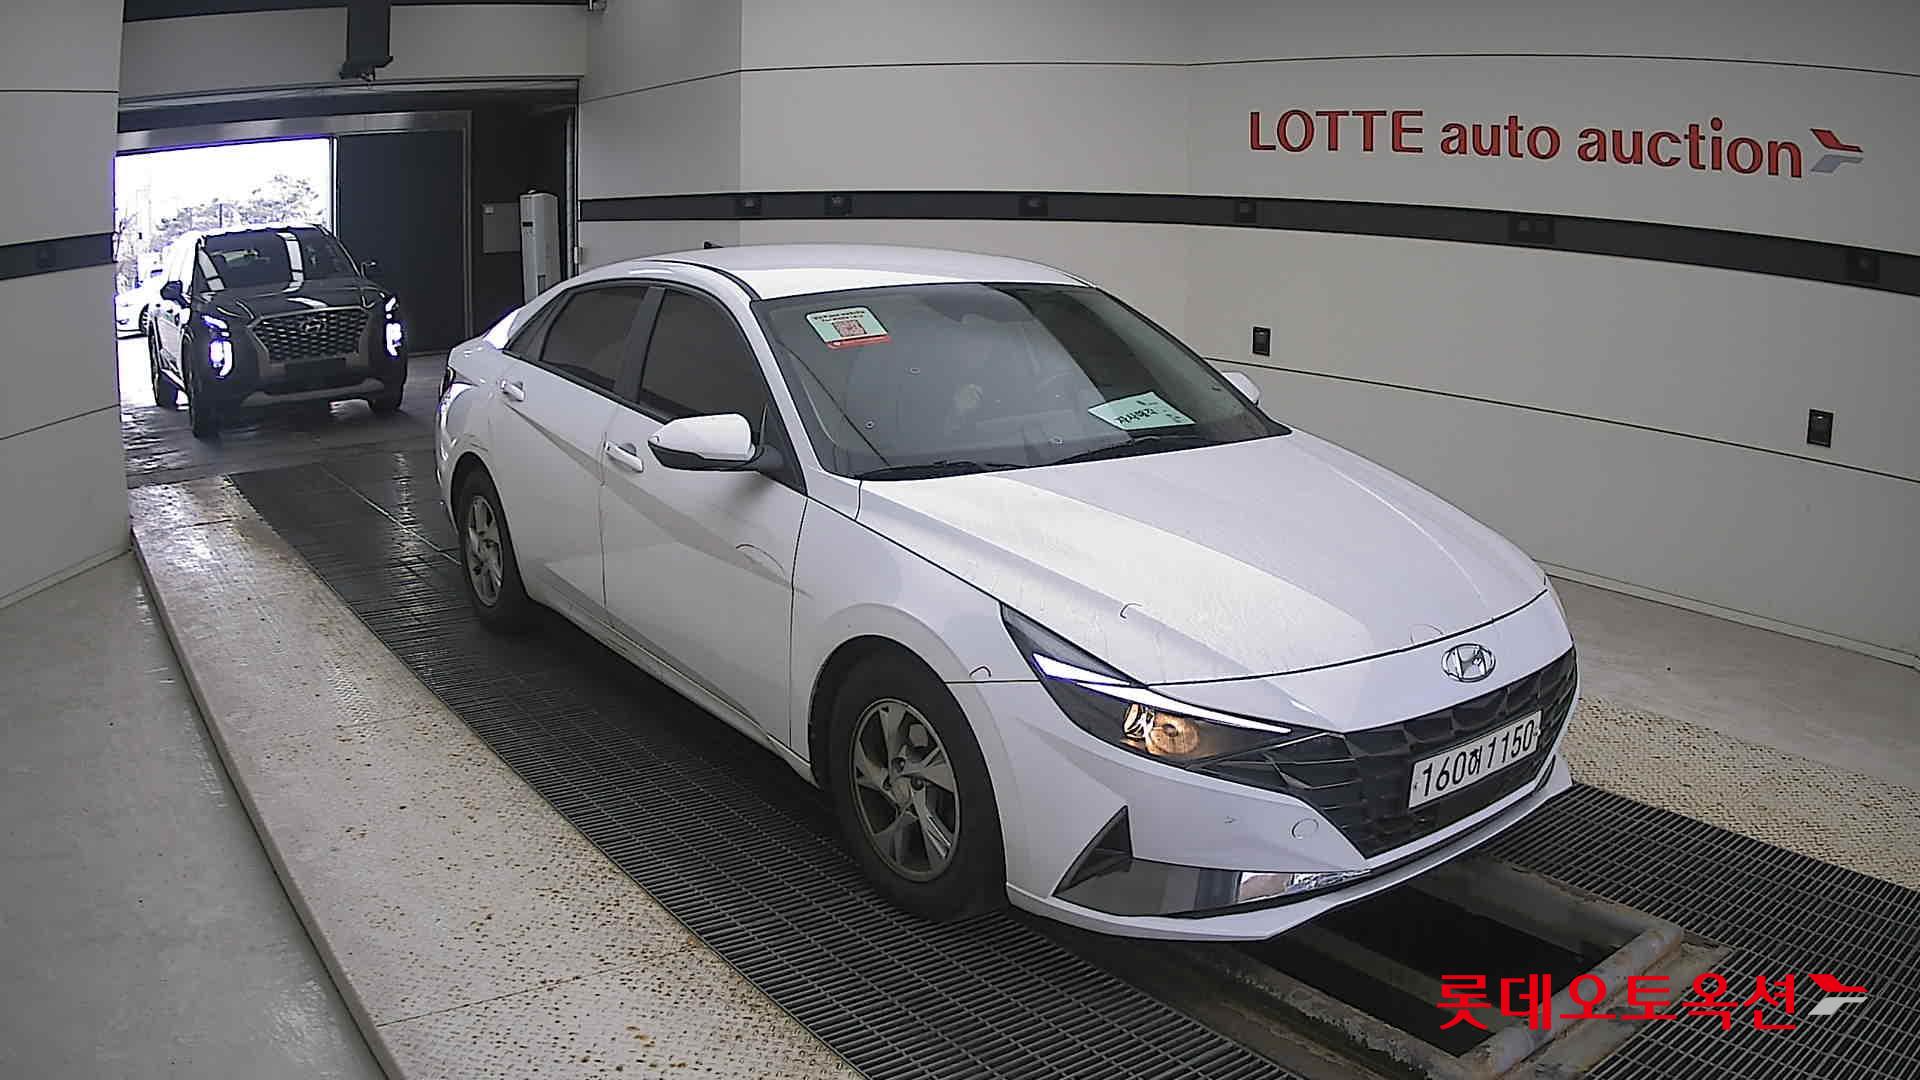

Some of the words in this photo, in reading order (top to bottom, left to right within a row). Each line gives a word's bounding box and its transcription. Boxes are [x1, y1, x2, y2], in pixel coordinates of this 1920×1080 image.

[1249, 110, 1424, 154] LOTTE
[1440, 115, 1561, 161] auto
[1576, 117, 1803, 179] auction
